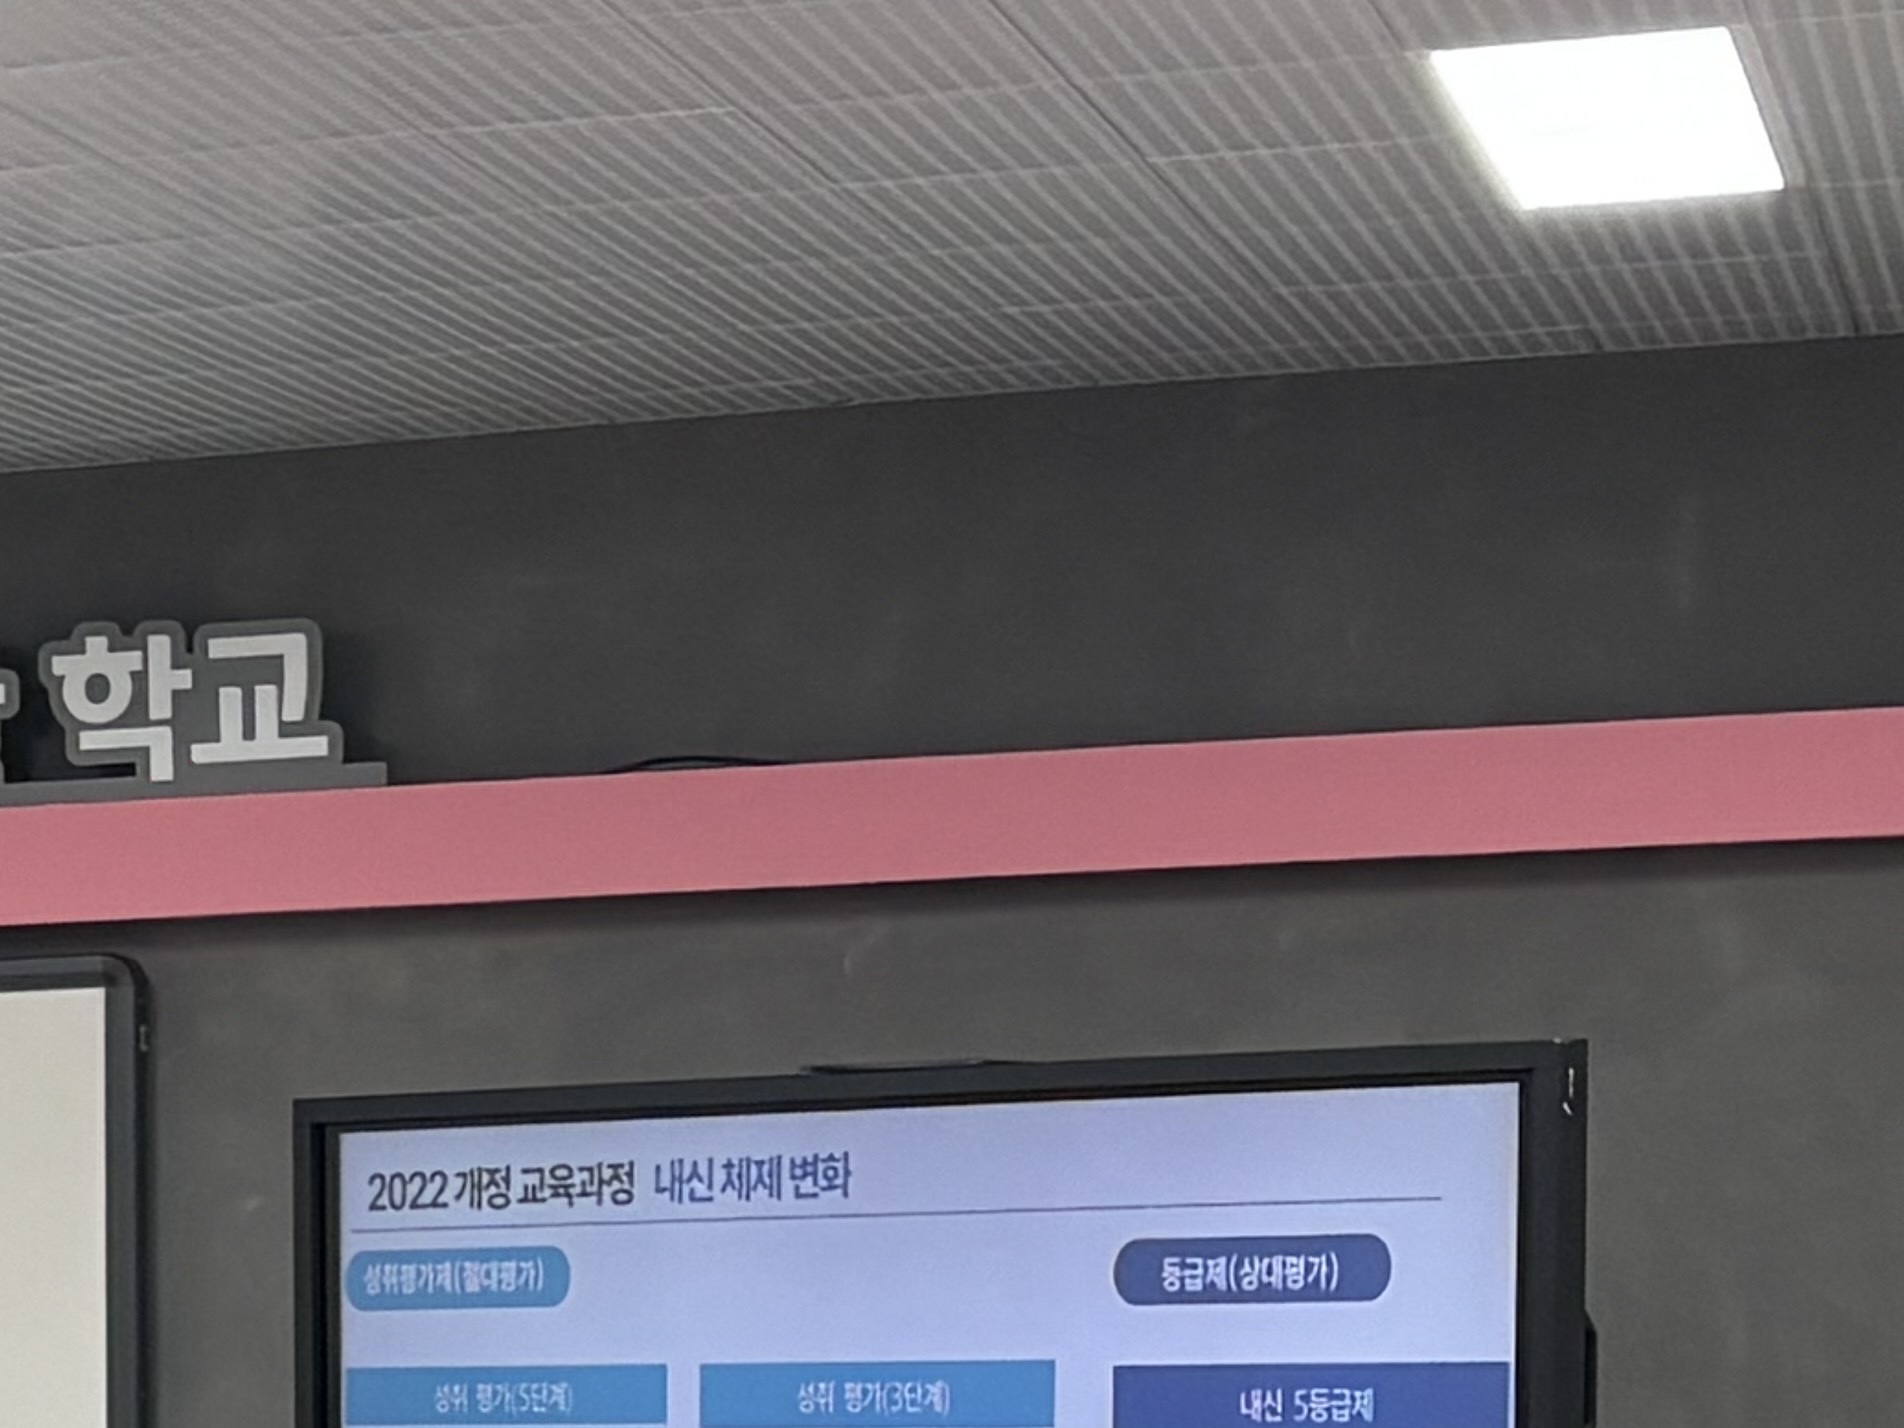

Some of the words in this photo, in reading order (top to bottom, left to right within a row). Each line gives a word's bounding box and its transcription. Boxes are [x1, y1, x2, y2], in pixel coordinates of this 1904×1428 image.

[51, 633, 328, 784] 학교
[368, 1170, 448, 1211] 2022
[455, 1165, 511, 1210] 개정
[517, 1160, 634, 1207] 교육과정
[655, 1157, 714, 1204] 내신
[721, 1155, 782, 1202] 체제
[790, 1151, 851, 1199] 변화
[1162, 1252, 1338, 1291] 등급제(상대평가)
[1240, 1389, 1282, 1422] 내신
[1294, 1388, 1373, 1422] 5등급제
